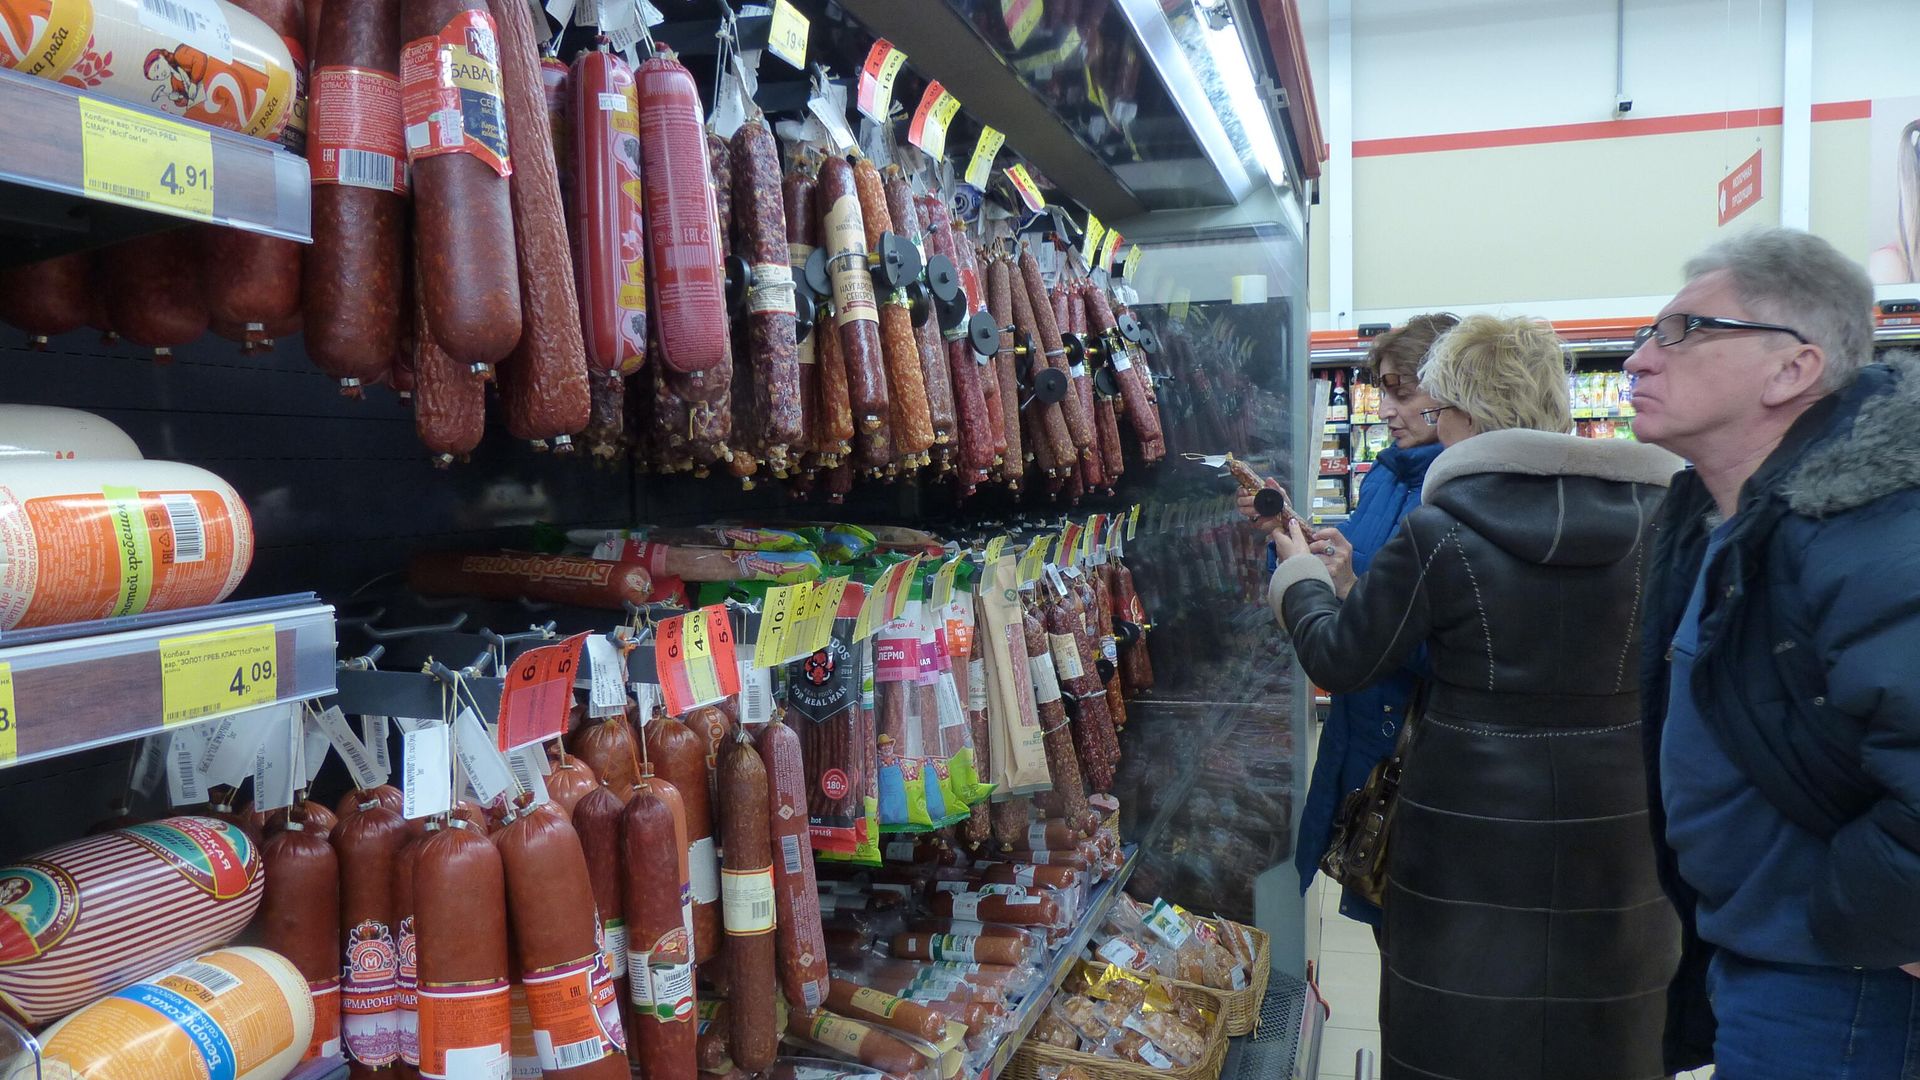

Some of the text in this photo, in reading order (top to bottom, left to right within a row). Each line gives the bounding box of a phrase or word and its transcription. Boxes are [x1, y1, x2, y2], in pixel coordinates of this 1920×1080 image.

[118, 503, 143, 572] гребешок
[162, 650, 191, 660] Колбаса
[830, 638, 852, 661] DOS
[877, 650, 905, 661] ЛЕРМО
[804, 695, 828, 707] REAL
[828, 684, 848, 702] MAN
[810, 816, 822, 824] hot
[809, 828, 832, 838] ТРЫЙ
[177, 819, 232, 871] ОРСКАЯ
[141, 993, 222, 1071] Белорусская
[184, 1002, 219, 1039] сальцем
